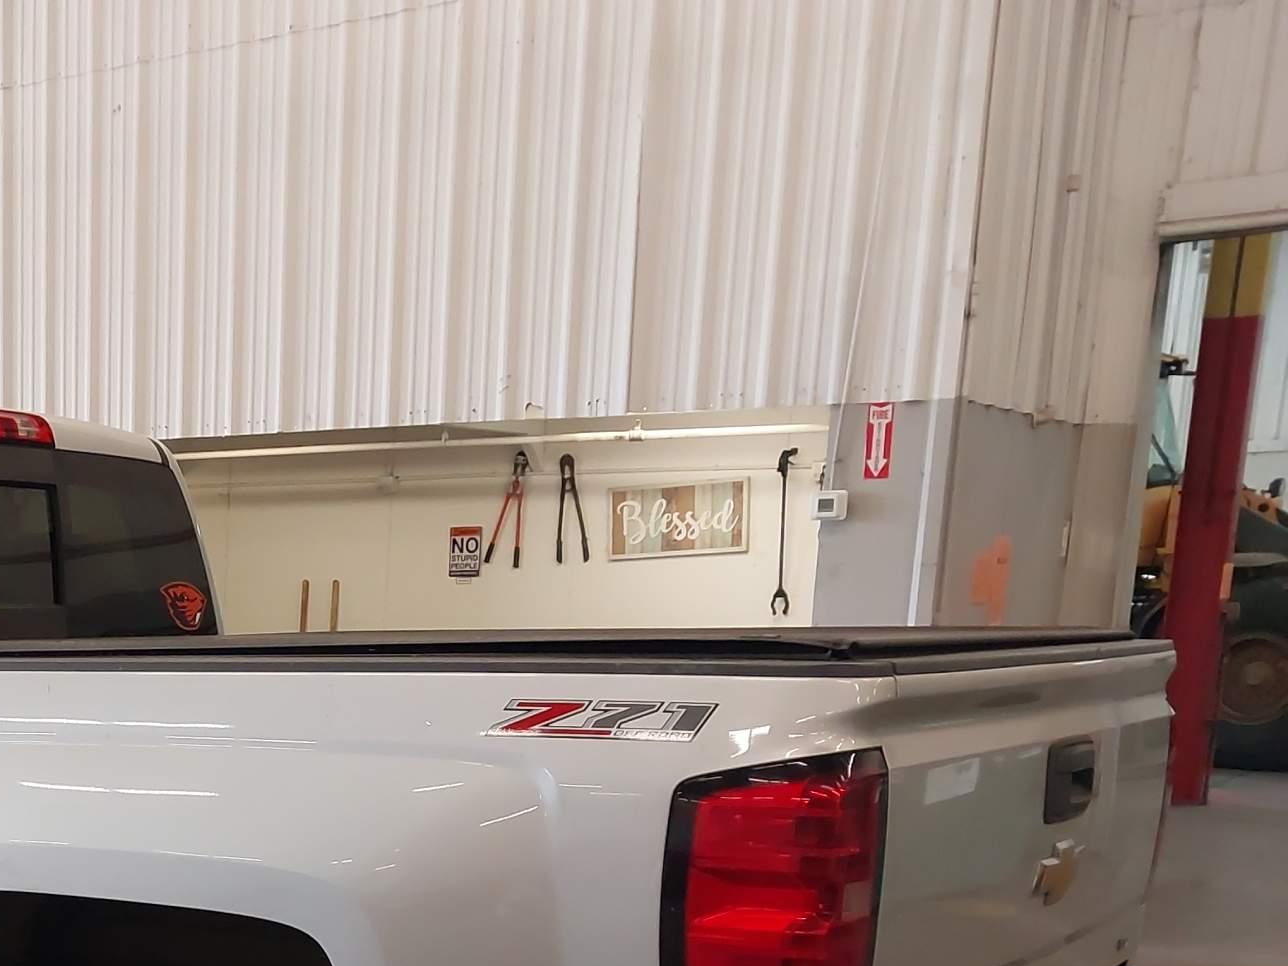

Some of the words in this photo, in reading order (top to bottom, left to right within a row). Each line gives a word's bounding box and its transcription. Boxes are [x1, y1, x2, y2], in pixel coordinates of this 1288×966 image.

[872, 409, 889, 420] FIRE
[616, 498, 740, 545] Blessed
[452, 537, 479, 554] NO
[451, 554, 479, 562] STUPID
[450, 562, 477, 570] PEOPLE
[486, 698, 720, 737] Z71
